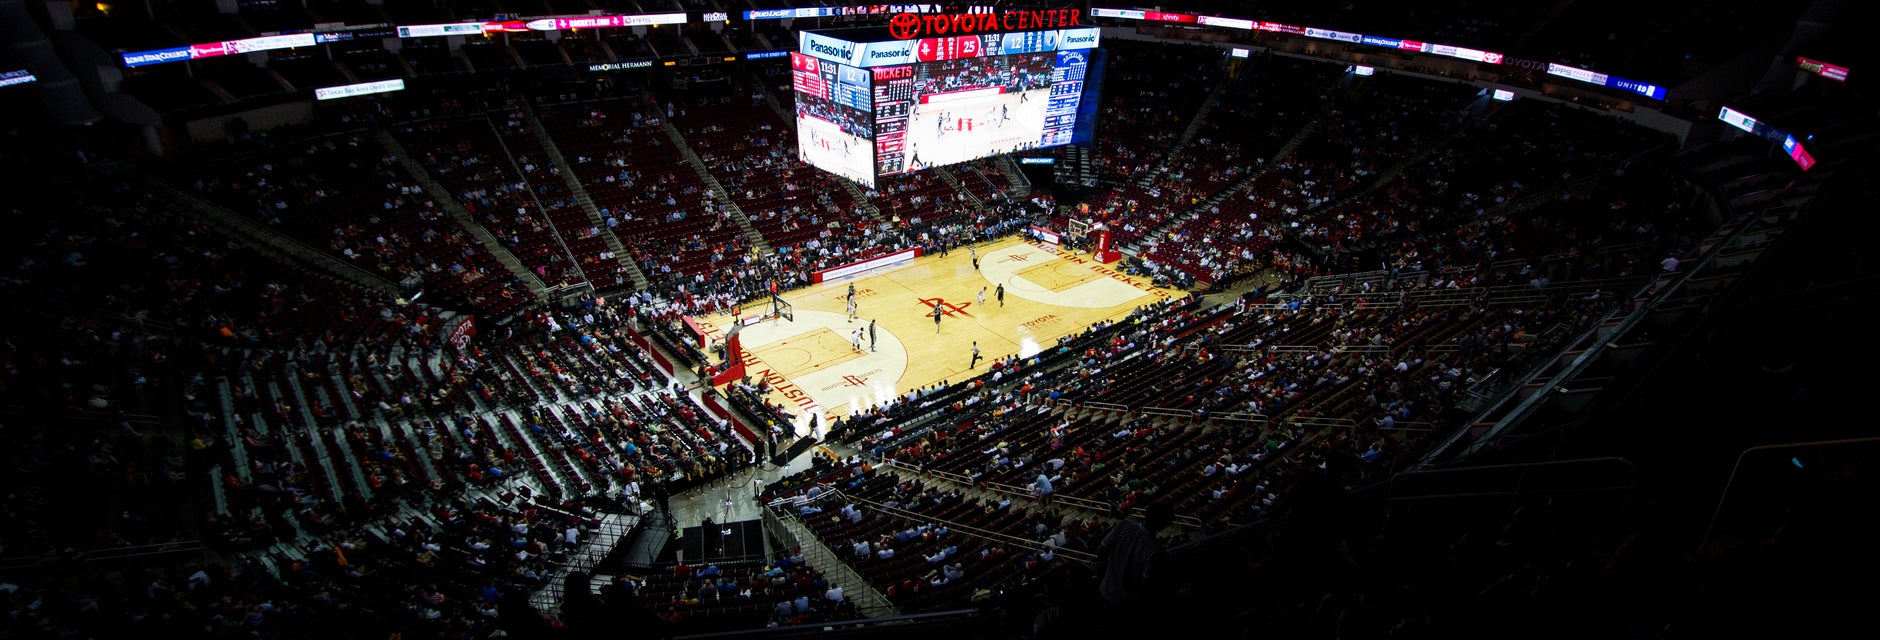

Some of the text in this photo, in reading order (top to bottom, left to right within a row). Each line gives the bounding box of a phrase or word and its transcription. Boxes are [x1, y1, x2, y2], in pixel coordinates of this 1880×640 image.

[923, 9, 1080, 34] TOYOTA CENTER
[984, 34, 1000, 42] 11:31
[1010, 38, 1021, 49] 12
[1067, 34, 1095, 43] Panasonic
[811, 39, 852, 60] Panasonic
[871, 47, 910, 58] Panasonic
[963, 41, 975, 53] 25
[125, 55, 144, 64] LONE
[160, 50, 188, 61] COLLEGE
[589, 60, 653, 71] MEMORIAL HERMANN
[805, 57, 815, 71] 25
[821, 61, 837, 75] 11:31
[846, 68, 856, 81] 12
[1554, 66, 1573, 76] PPS
[327, 88, 344, 96] Texas
[344, 87, 355, 95] Bay
[369, 83, 386, 91] Credit
[1617, 80, 1647, 93] UNITED
[1090, 265, 1169, 297] ROCKETS
[836, 288, 873, 301] TOOTA
[1021, 314, 1057, 328] TOYOTA
[450, 320, 473, 345] TOYOTA
